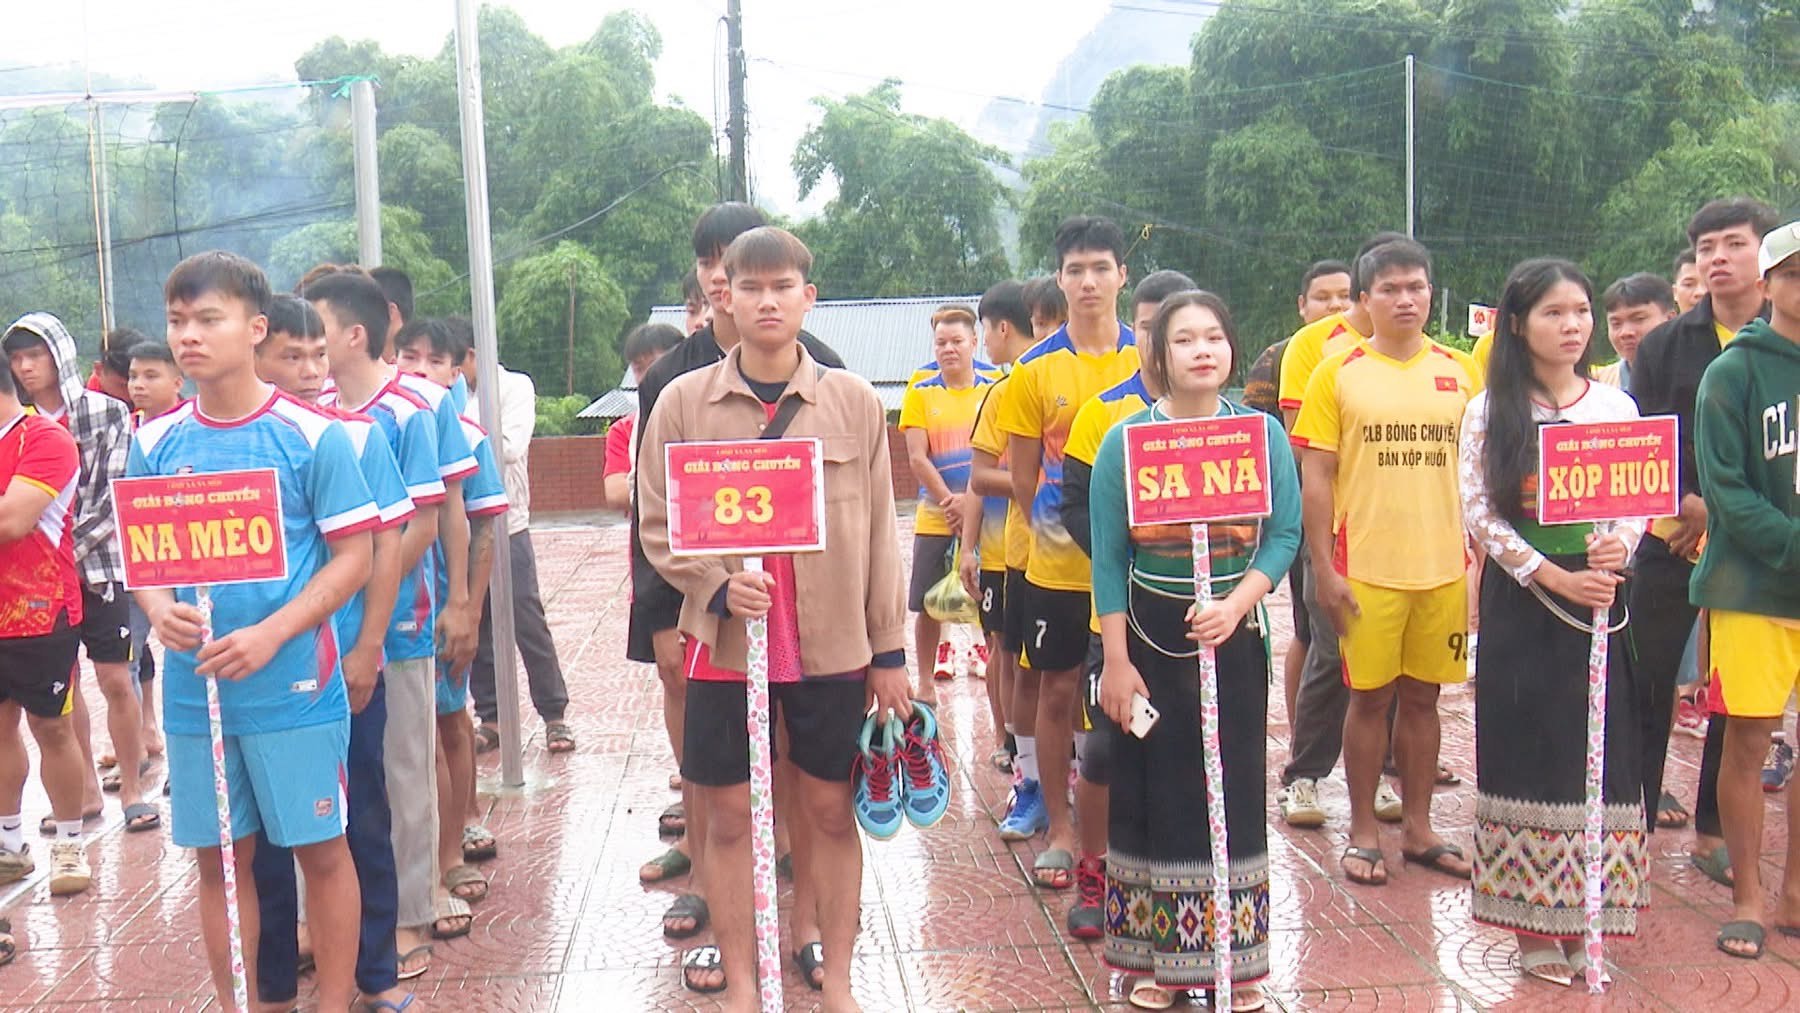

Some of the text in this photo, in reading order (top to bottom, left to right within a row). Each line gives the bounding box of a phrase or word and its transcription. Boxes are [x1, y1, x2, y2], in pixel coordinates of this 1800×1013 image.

[1362, 424, 1382, 443] CLB
[1137, 450, 1263, 501] SA NÁ
[1548, 447, 1670, 508] XỘP HUỐI
[714, 485, 774, 525] 83
[127, 509, 274, 563] NA MÈO
[982, 587, 994, 612] 8
[1035, 619, 1047, 649] 7
